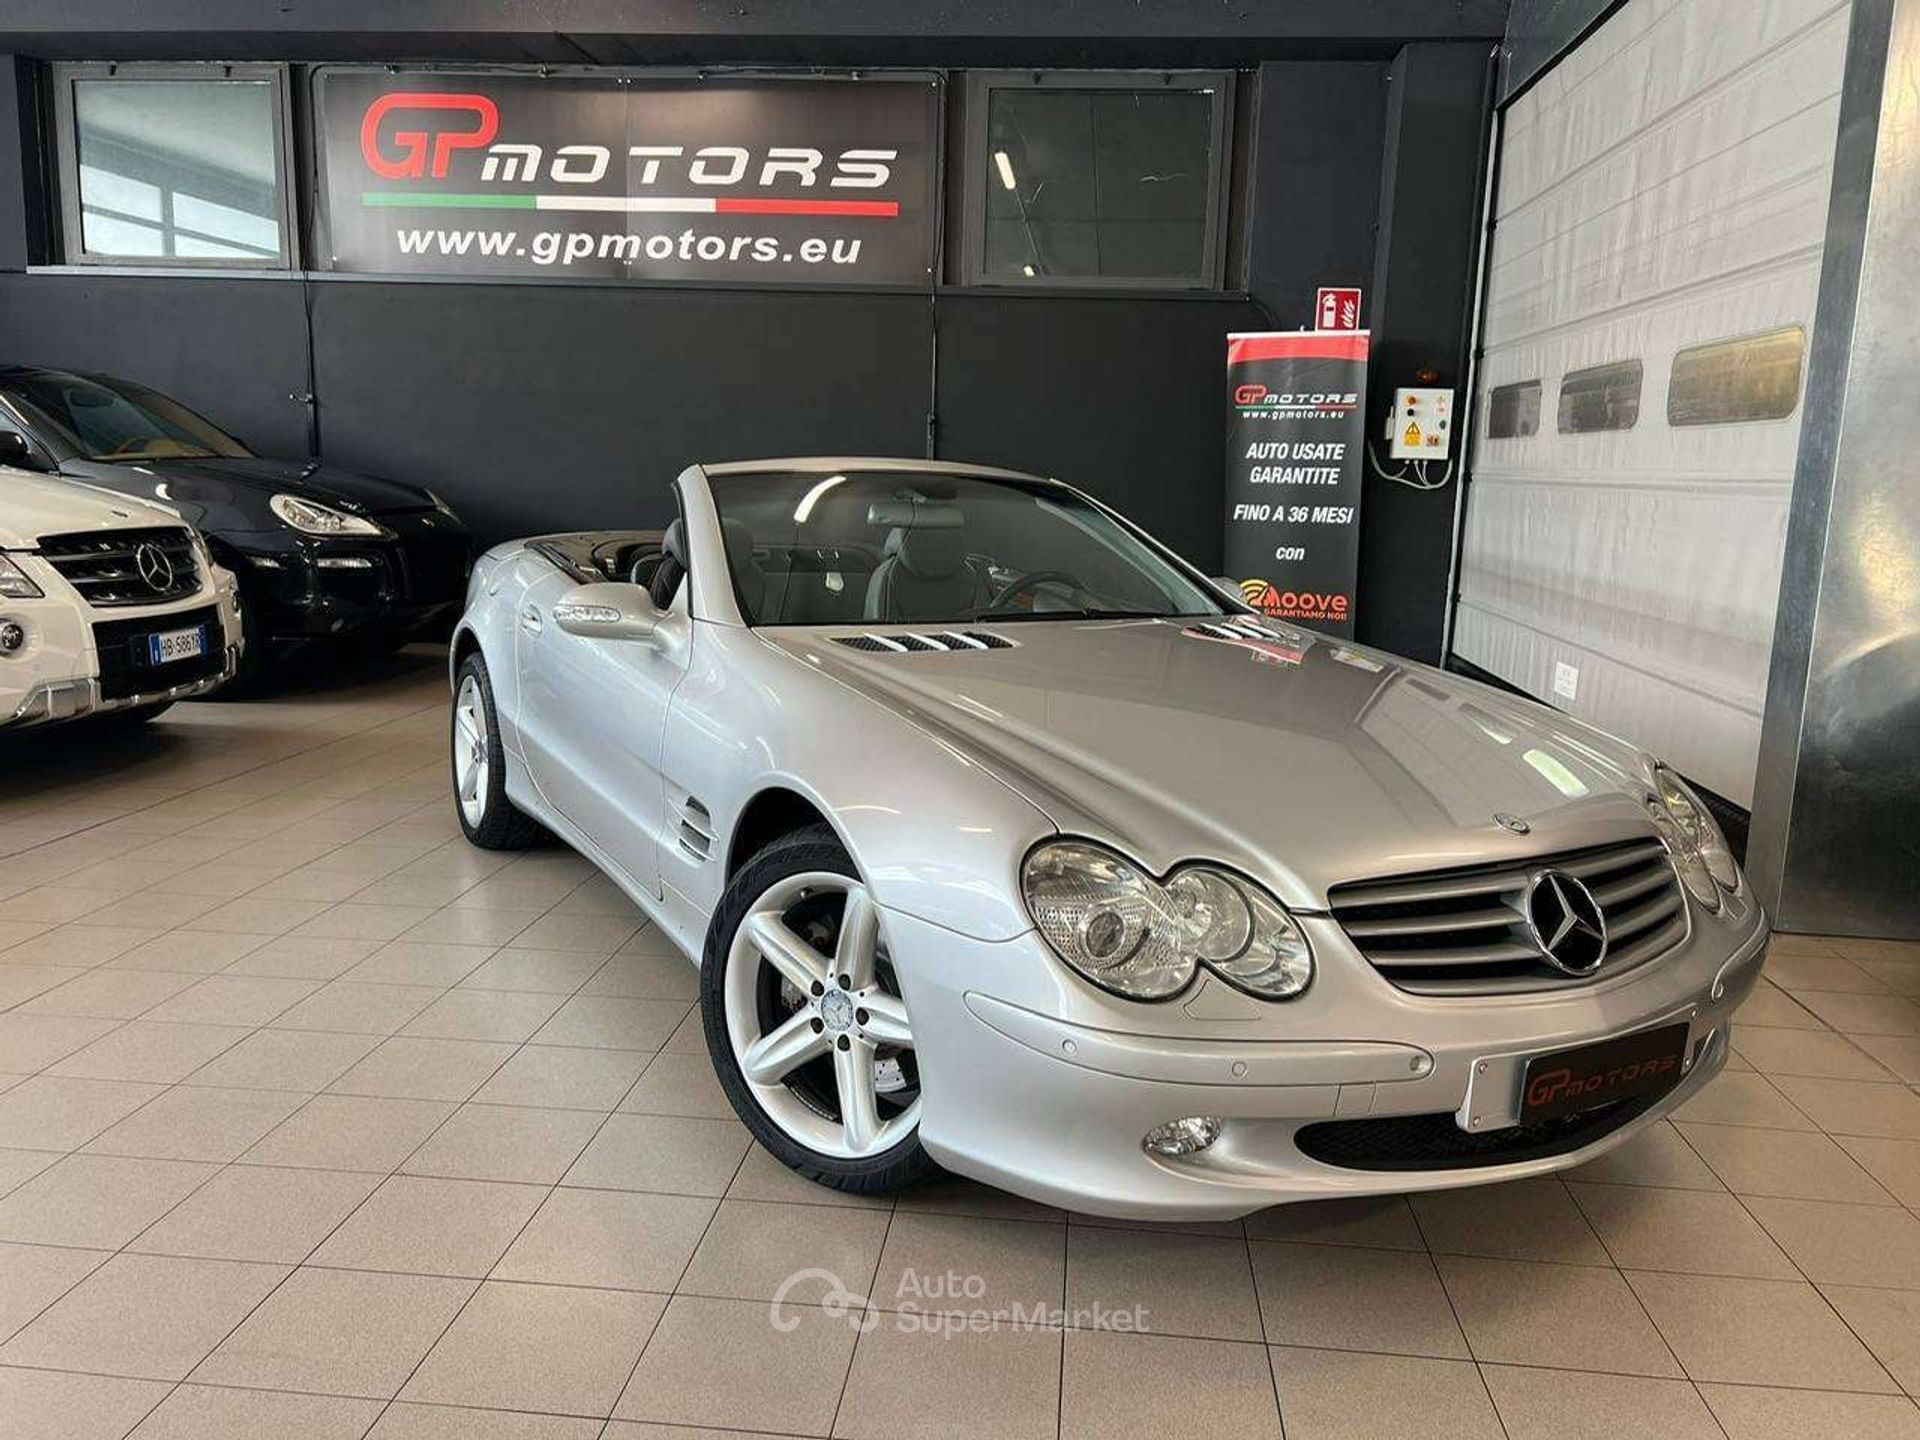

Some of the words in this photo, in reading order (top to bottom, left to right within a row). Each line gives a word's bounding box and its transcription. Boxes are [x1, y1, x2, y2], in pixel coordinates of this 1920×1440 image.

[361, 92, 500, 180] GP
[396, 227, 863, 265] www.gpmotors.eu
[1242, 410, 1345, 421] www.gpmotors.eu
[1246, 442, 1289, 460] AUTO
[1292, 443, 1346, 461] USATE
[1249, 466, 1341, 485] GARANTITE
[1233, 504, 1271, 522] FINO
[1272, 507, 1285, 522] A
[1288, 507, 1310, 523] 36
[1311, 507, 1355, 524] MESI
[1275, 545, 1305, 561] con
